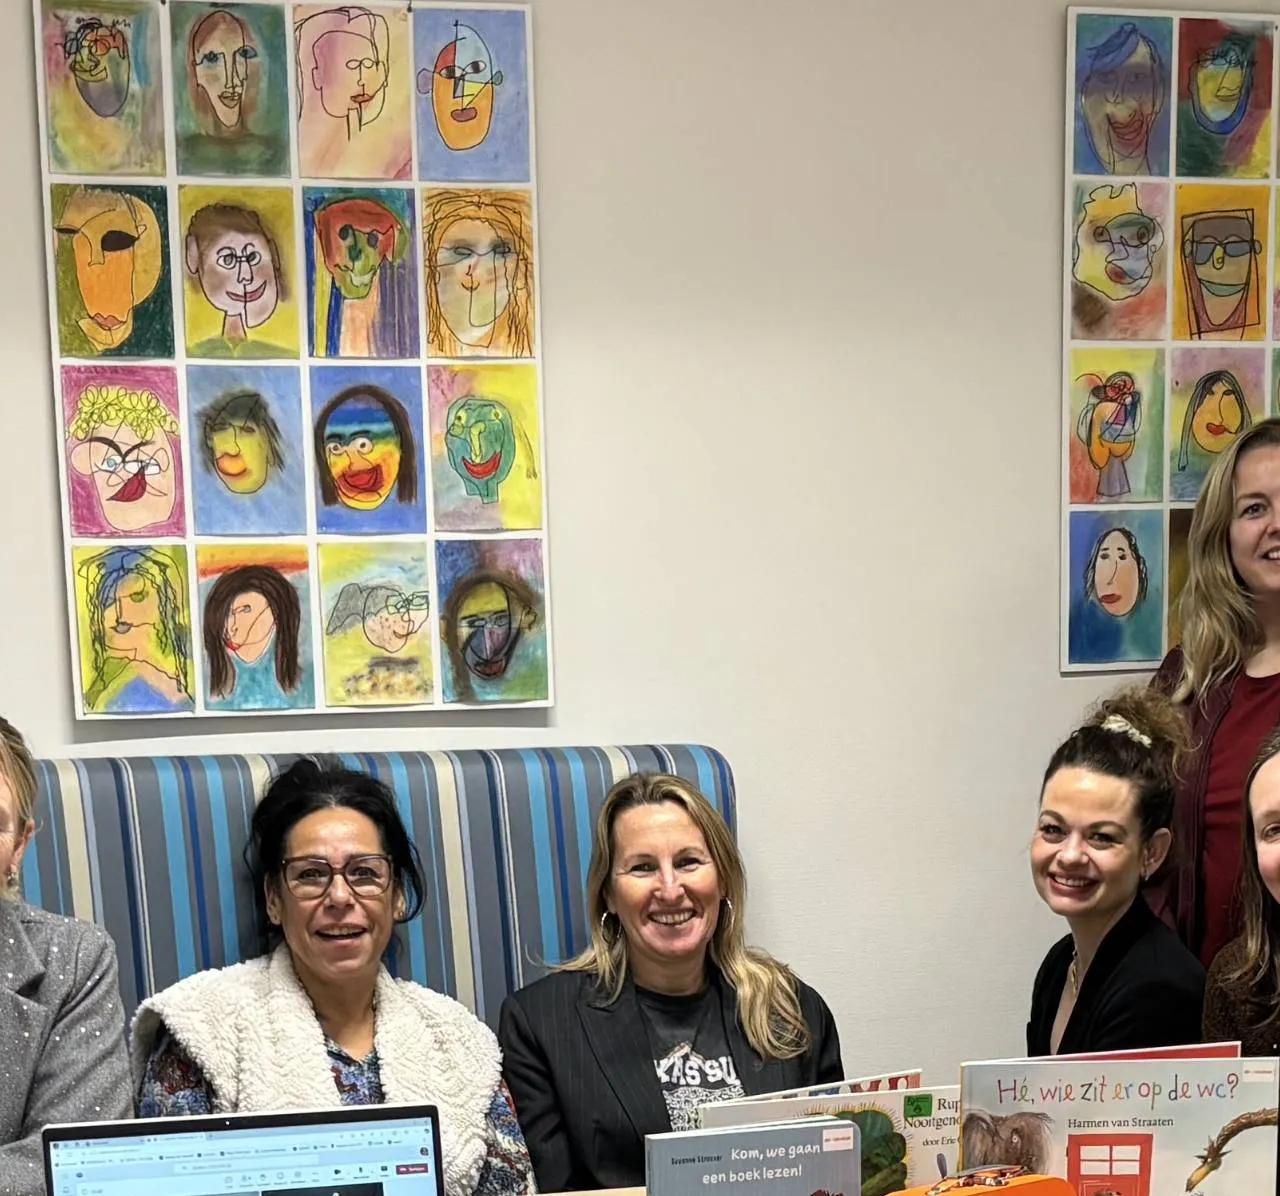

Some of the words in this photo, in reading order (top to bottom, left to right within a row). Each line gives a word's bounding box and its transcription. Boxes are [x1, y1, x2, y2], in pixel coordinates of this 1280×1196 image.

[997, 1076, 1034, 1105] Hé,
[1039, 1078, 1075, 1102] wie
[1081, 1075, 1107, 1103] zit
[1114, 1083, 1134, 1101] er
[1138, 1082, 1163, 1110] op
[1168, 1074, 1192, 1101] de
[1197, 1073, 1239, 1099] wc?
[1068, 1118, 1109, 1129] Harmen
[1110, 1119, 1130, 1128] van
[1131, 1117, 1174, 1128] Straaten
[731, 1147, 764, 1162] Kom,
[766, 1147, 786, 1158] we
[789, 1144, 821, 1159] gaan
[702, 1172, 726, 1185] een
[729, 1168, 761, 1182] boek
[763, 1165, 803, 1180] lezen!
